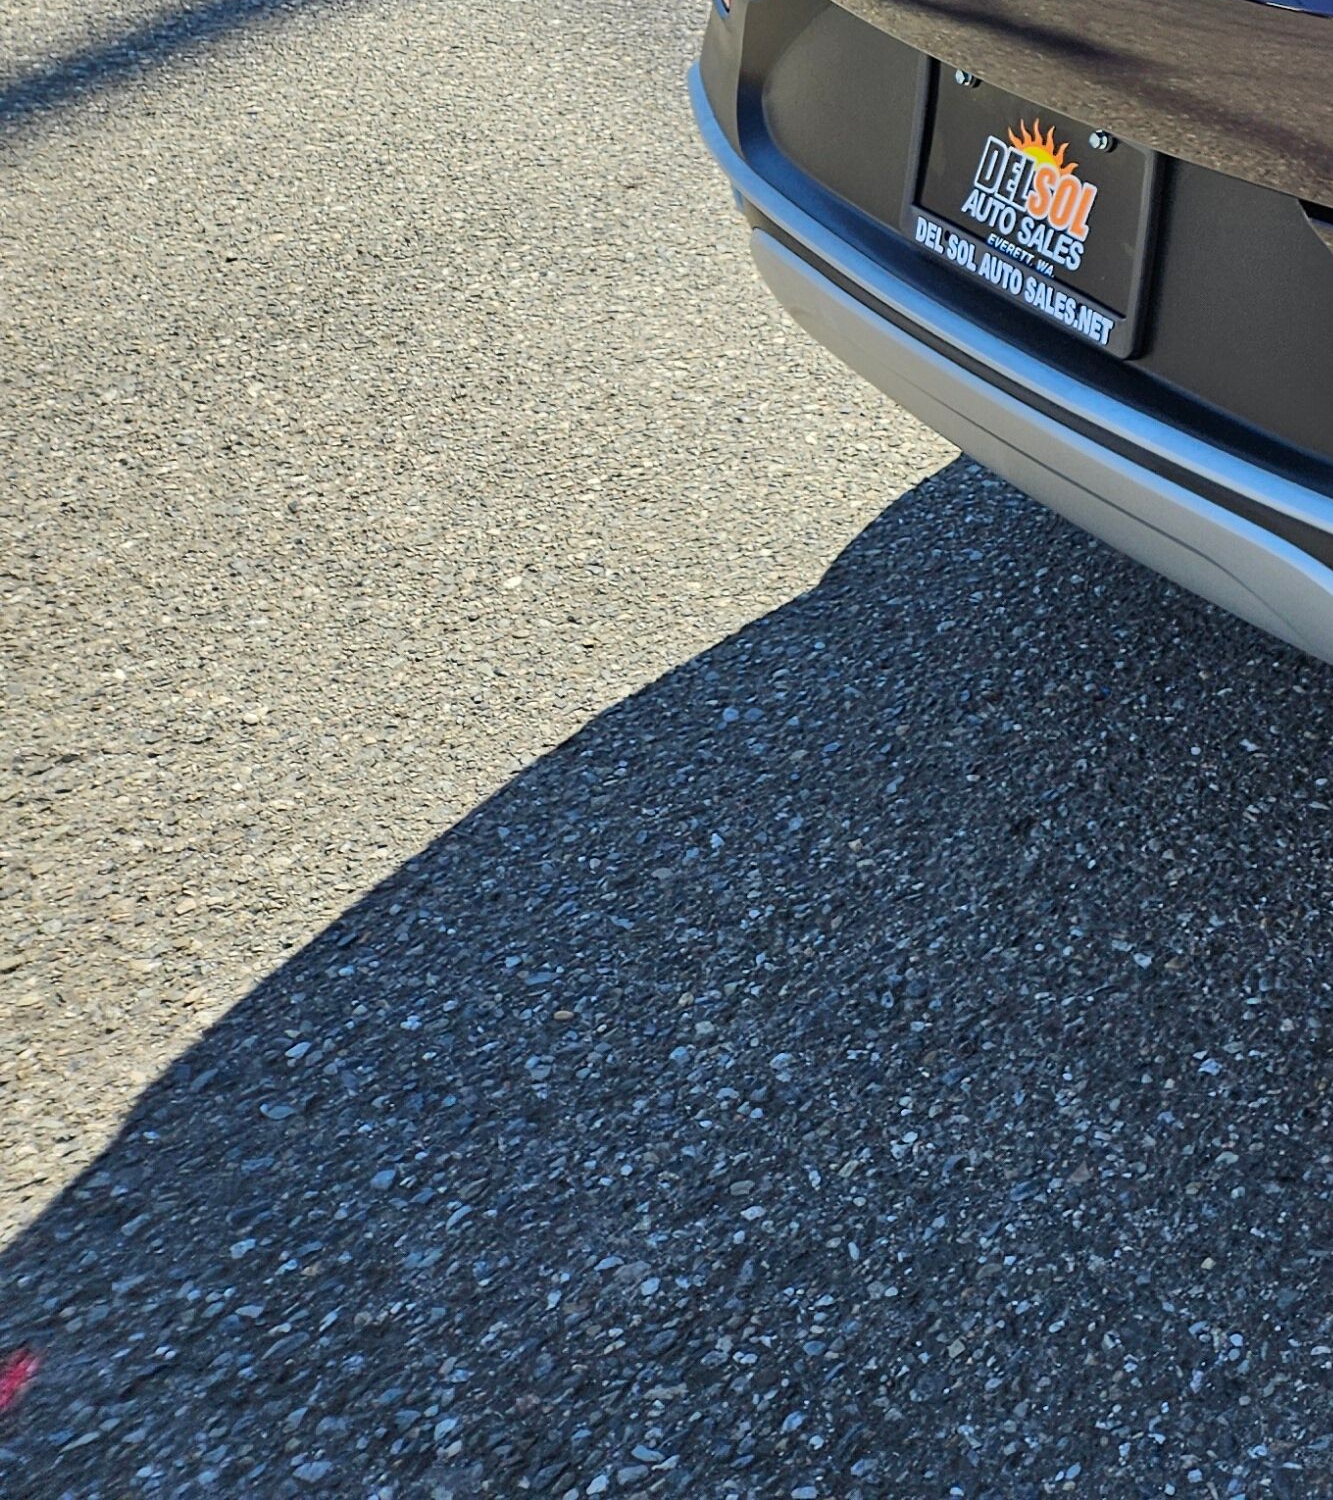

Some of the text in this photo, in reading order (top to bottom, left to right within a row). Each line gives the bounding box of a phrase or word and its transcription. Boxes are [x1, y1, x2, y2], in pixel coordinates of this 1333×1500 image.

[915, 216, 1115, 347] DEL SOL AUTO SALES.NET
[962, 188, 1085, 272] AUTO SALES
